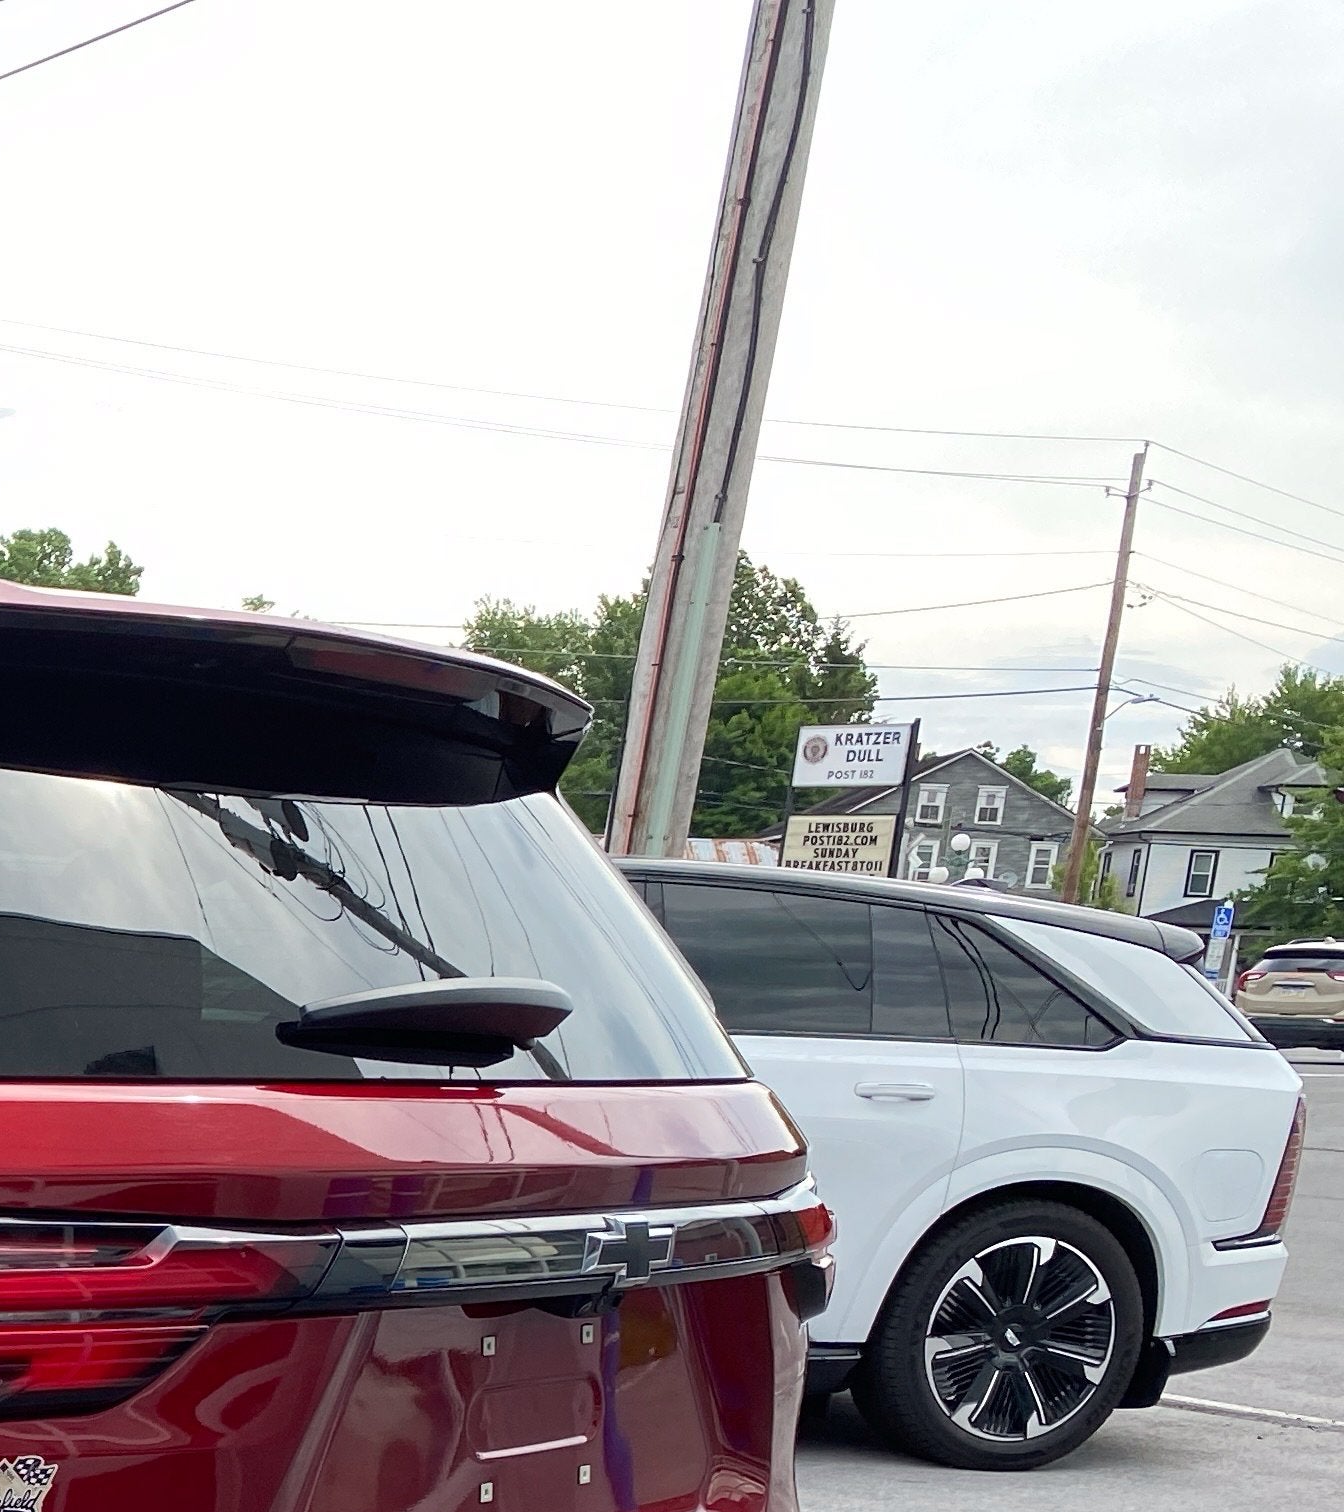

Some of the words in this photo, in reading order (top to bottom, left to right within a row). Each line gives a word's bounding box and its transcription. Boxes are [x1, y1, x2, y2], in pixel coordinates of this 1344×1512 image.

[835, 731, 902, 746] KRATZER
[846, 748, 883, 762] DULL
[827, 770, 856, 780] POST
[859, 769, 874, 779] 182
[808, 822, 874, 834] LEWISBURG
[813, 847, 859, 859] SUNDAY
